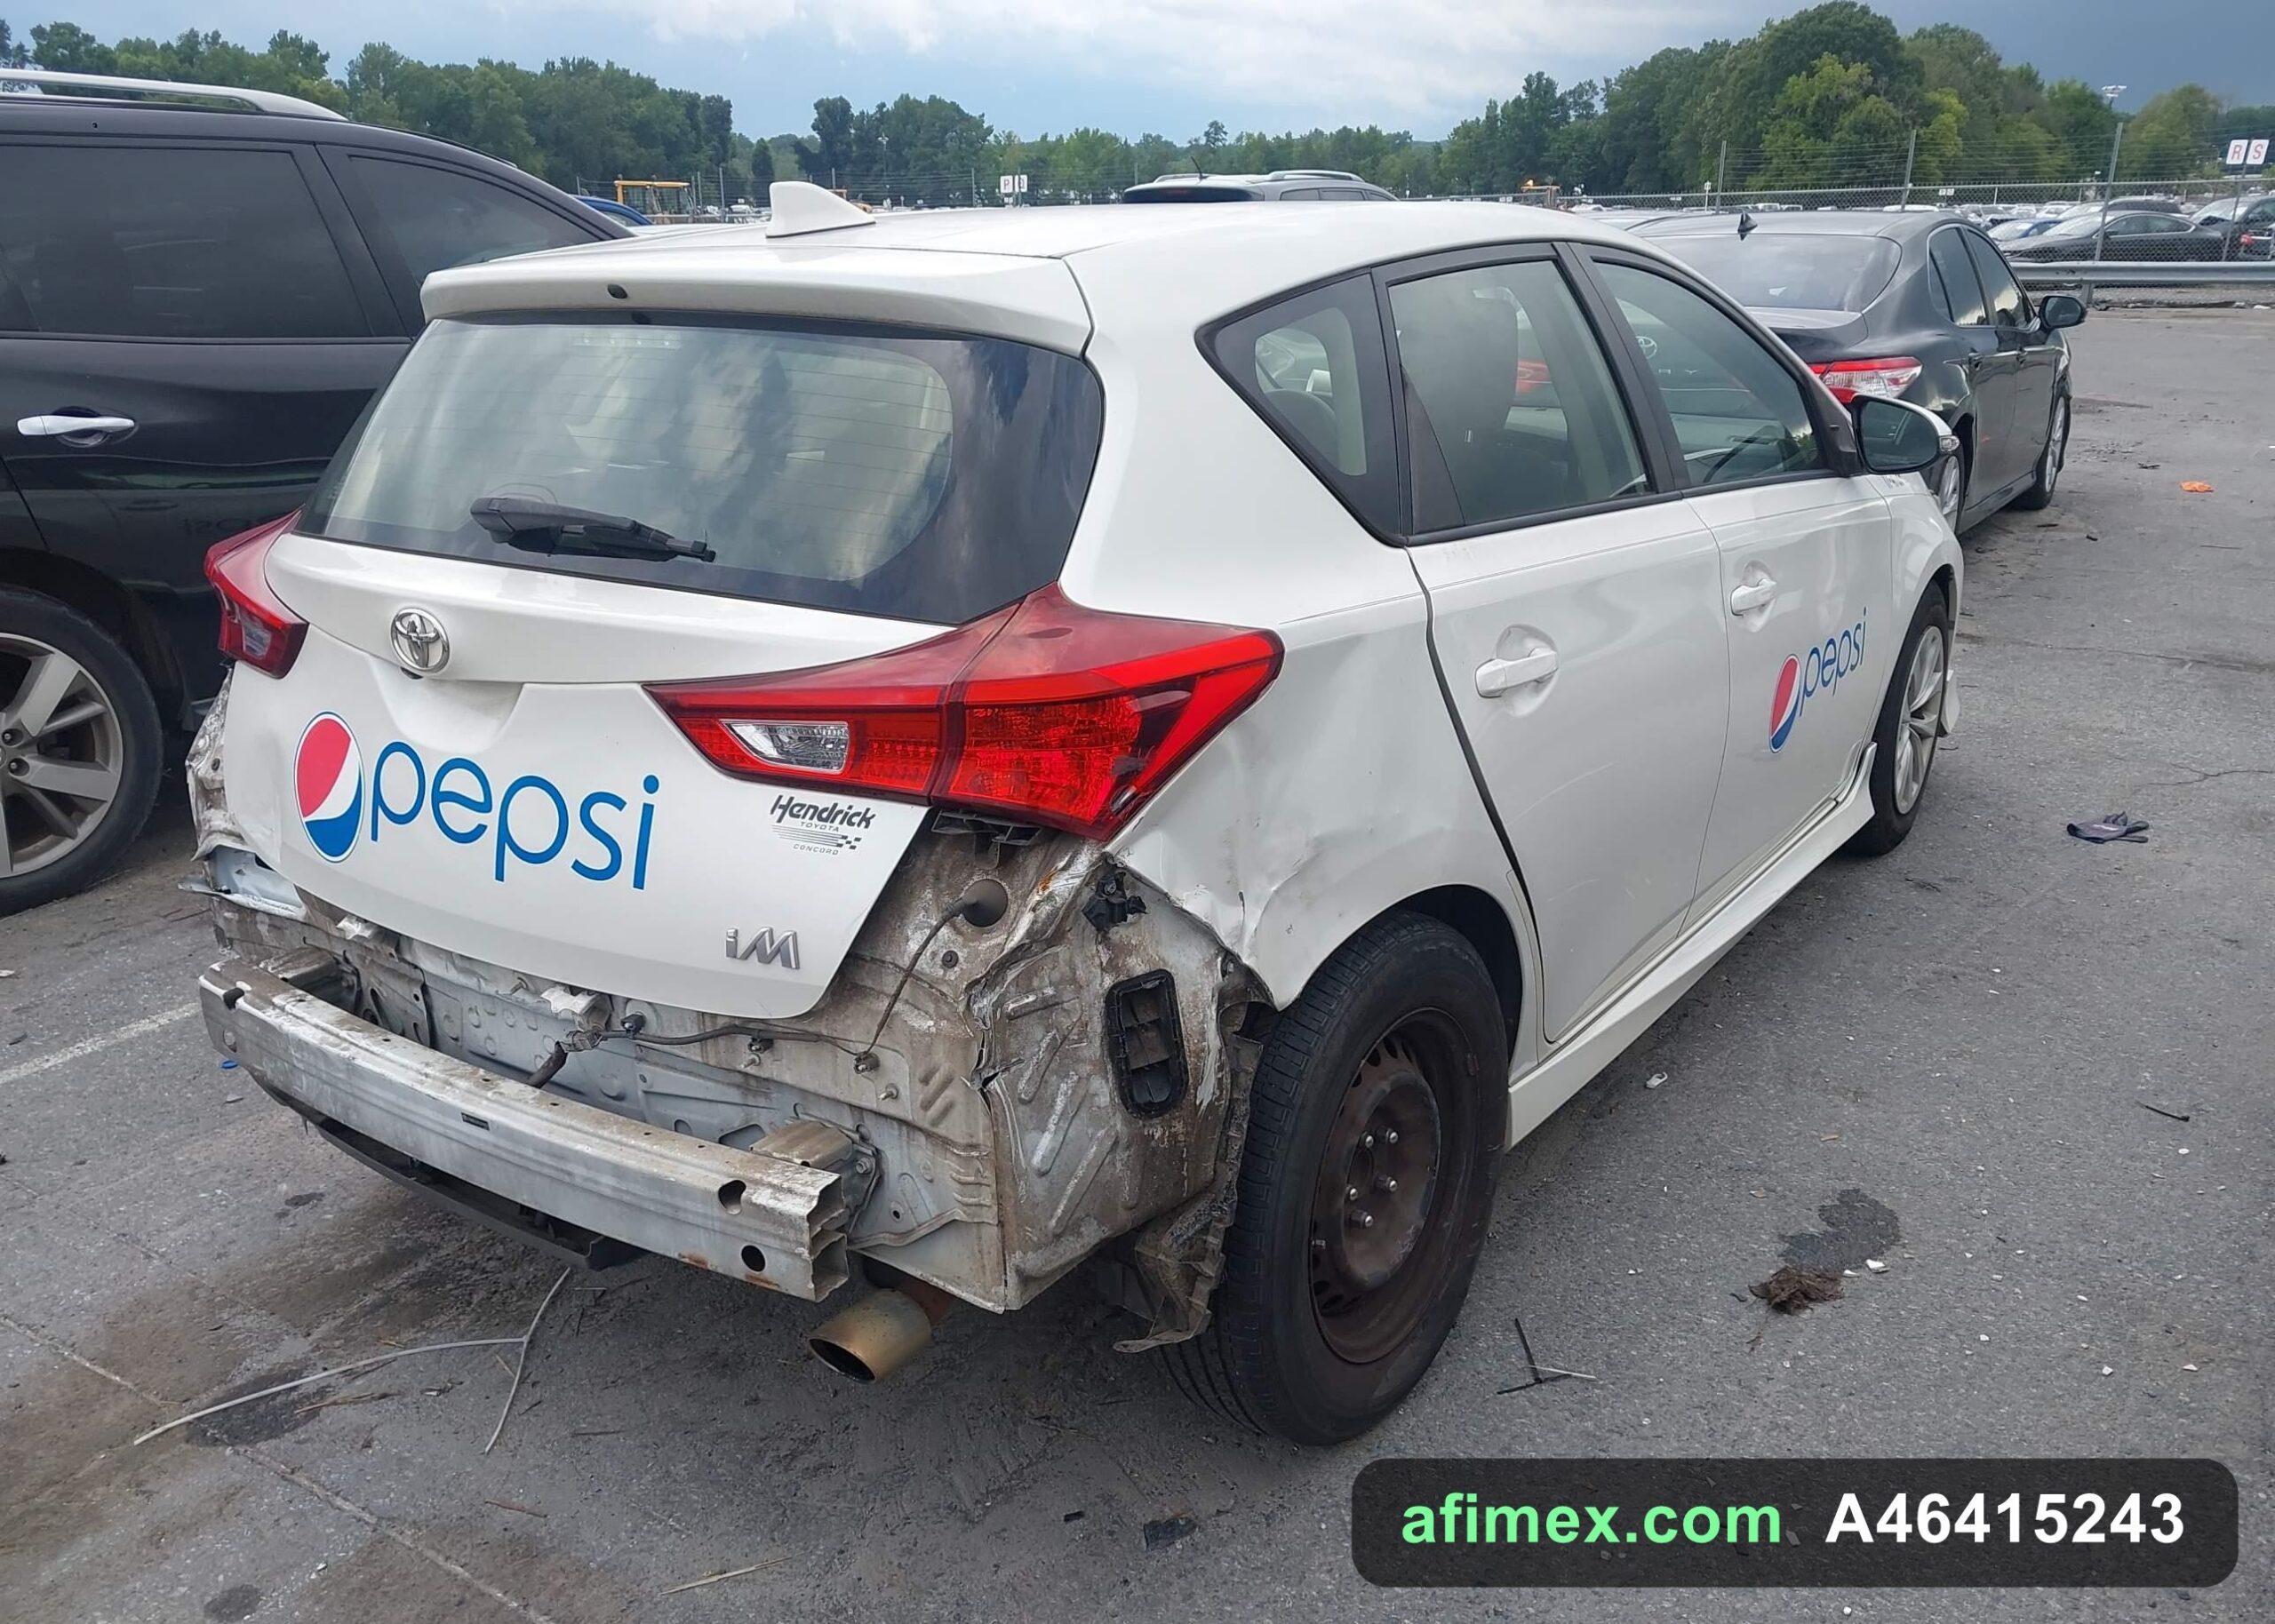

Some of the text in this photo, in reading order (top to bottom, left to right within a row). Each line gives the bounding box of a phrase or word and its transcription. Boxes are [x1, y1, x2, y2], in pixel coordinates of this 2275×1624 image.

[2231, 143, 2263, 160] R S
[1799, 607, 1867, 717] pepsi
[371, 741, 659, 890] pepsi
[770, 794, 876, 829] Hendrick
[800, 821, 839, 832] TOYOTA
[793, 843, 839, 856] CONCORD
[725, 927, 800, 970] iM
